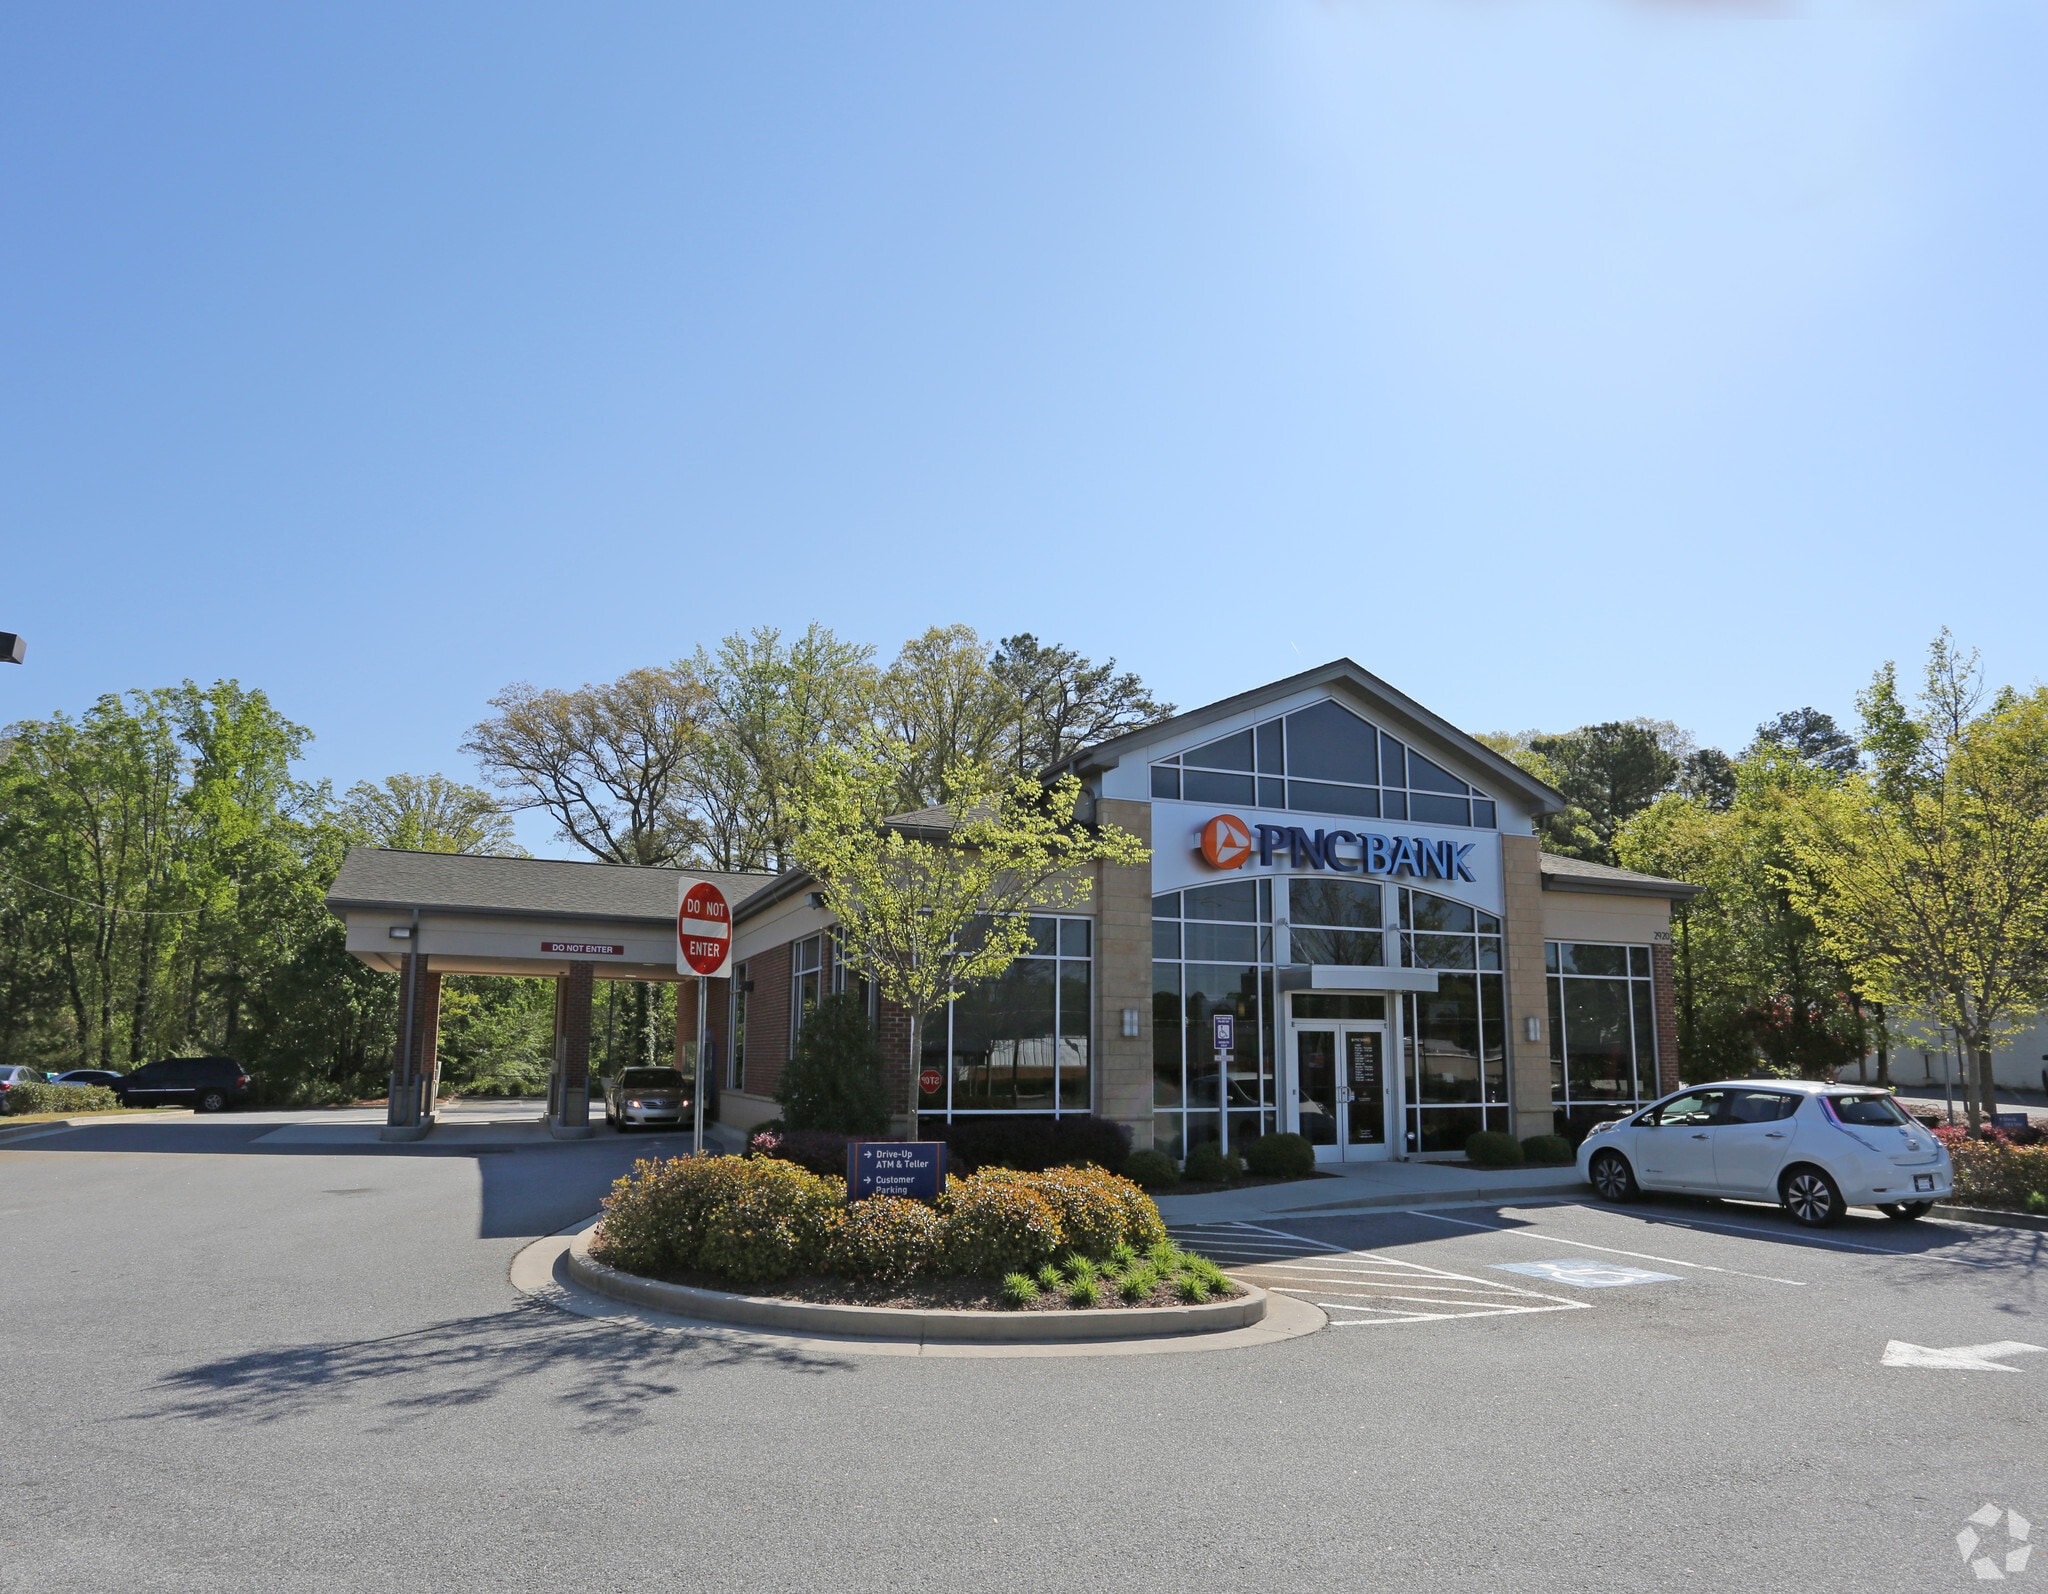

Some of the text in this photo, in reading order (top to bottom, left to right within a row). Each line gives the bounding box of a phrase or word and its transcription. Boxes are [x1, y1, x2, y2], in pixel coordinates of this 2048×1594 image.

[687, 898, 725, 917] DO NOT
[1653, 931, 1670, 940] 2920
[552, 943, 613, 953] DO NOT ENTER
[690, 941, 720, 957] ENTER
[876, 1150, 912, 1159] Drive-Up
[876, 1160, 929, 1169] ATM & Teller
[876, 1176, 915, 1184] Customer
[876, 1186, 908, 1195] Parking
